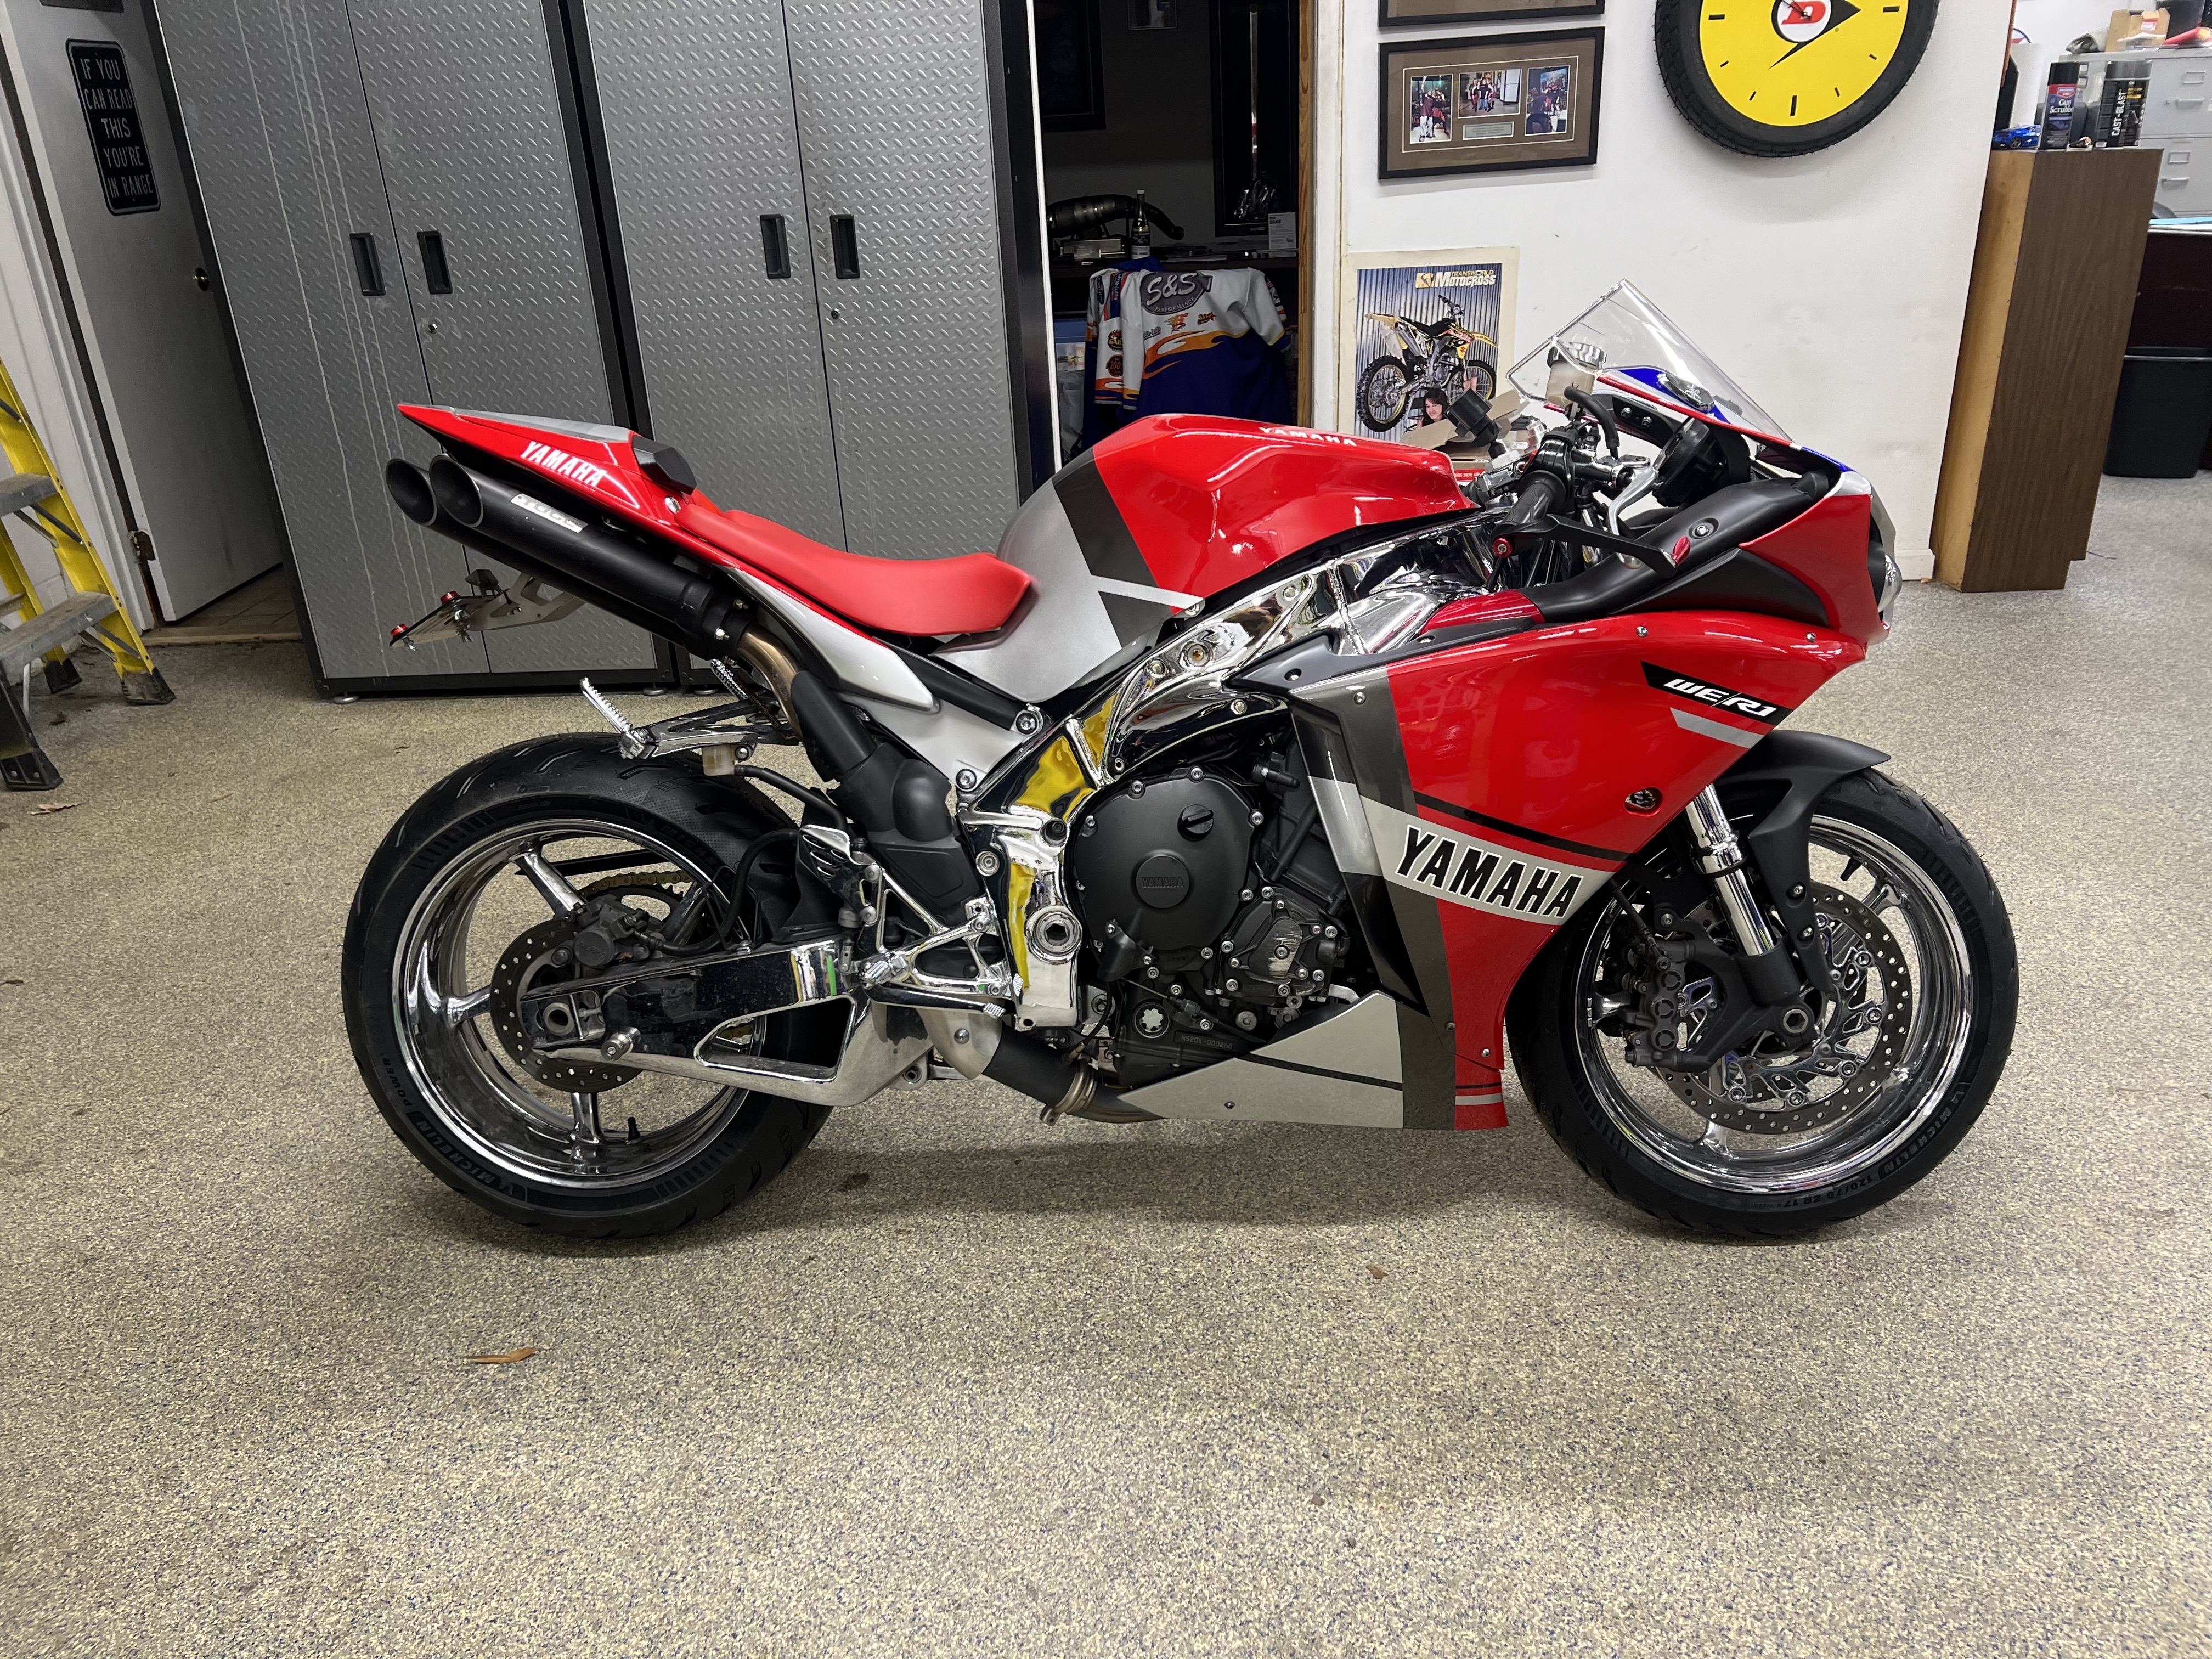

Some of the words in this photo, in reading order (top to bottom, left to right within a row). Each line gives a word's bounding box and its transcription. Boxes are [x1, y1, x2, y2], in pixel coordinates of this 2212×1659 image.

[80, 58, 91, 80] IF
[95, 59, 120, 80] YOU
[84, 88, 107, 110] CAN
[108, 88, 133, 109] READ
[2112, 91, 2127, 136] CAST-BLAST
[101, 118, 131, 138] THIS
[103, 146, 144, 167] YOU'RE
[108, 177, 120, 198] IN
[121, 174, 153, 198] RANGE
[1147, 273, 1197, 306] S&S
[1155, 296, 1194, 312] PERFORMANCE
[1259, 427, 1357, 447] YAMAHA
[520, 441, 607, 487] YAMAHA
[1141, 876, 1184, 888] YAMAHA
[1395, 824, 1584, 918] YAMAHA
[382, 1058, 413, 1106] POWER
[1883, 1107, 1951, 1174] MICHELIN
[416, 1121, 494, 1184] MICHELIN
[1827, 1175, 1874, 1199] 120/70
[1784, 1199, 1799, 1207] 17
[1803, 1194, 1821, 1205] ZR
